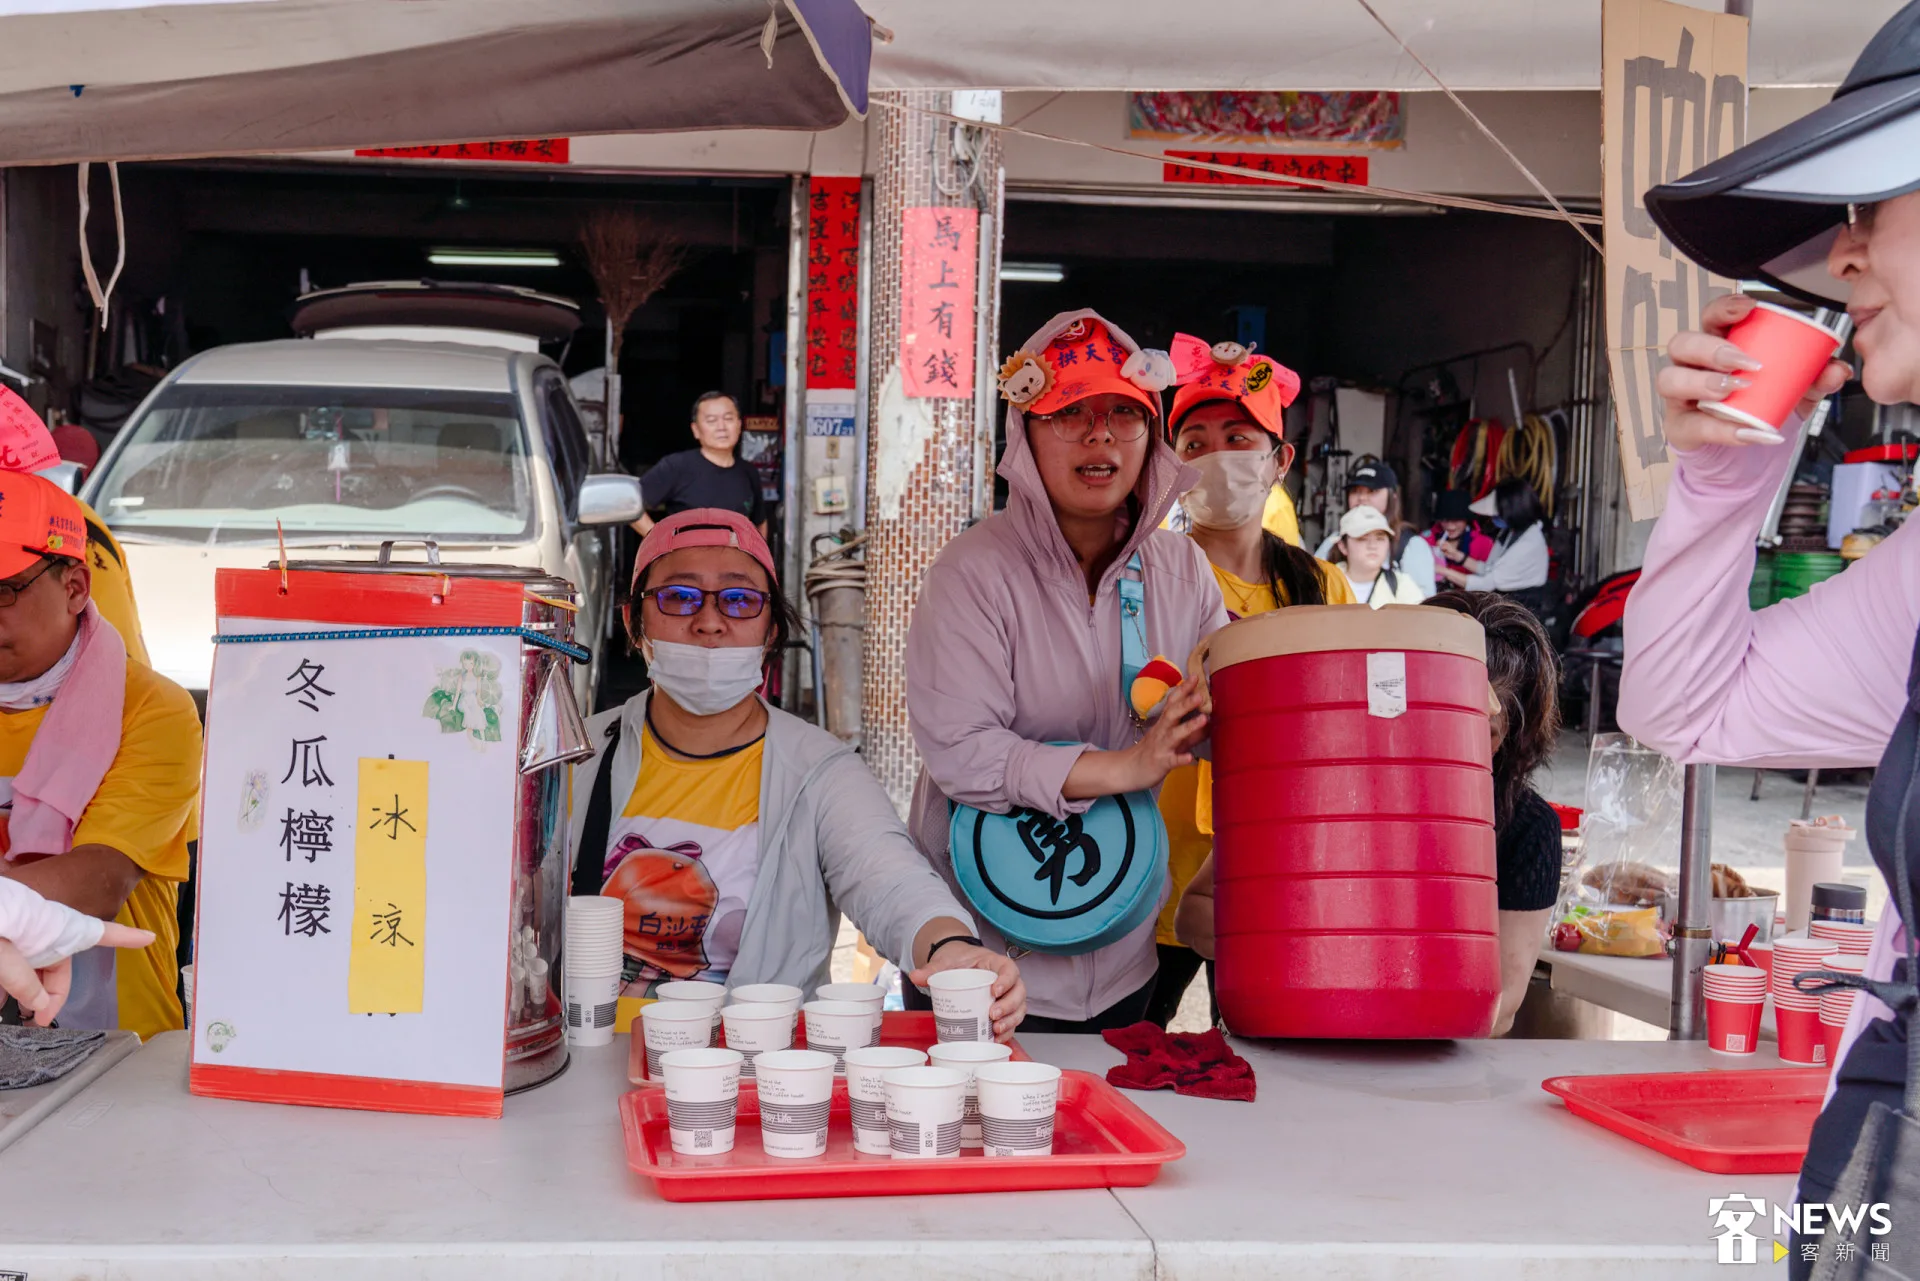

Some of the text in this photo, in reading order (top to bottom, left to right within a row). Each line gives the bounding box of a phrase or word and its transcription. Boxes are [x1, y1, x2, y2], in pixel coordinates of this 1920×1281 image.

[923, 215, 961, 389] 馬上有錢
[1057, 343, 1123, 369] 拱天宮
[277, 658, 336, 938] 冬瓜檸檬
[369, 794, 417, 947] 冰涼
[638, 911, 710, 938] 白沙屯
